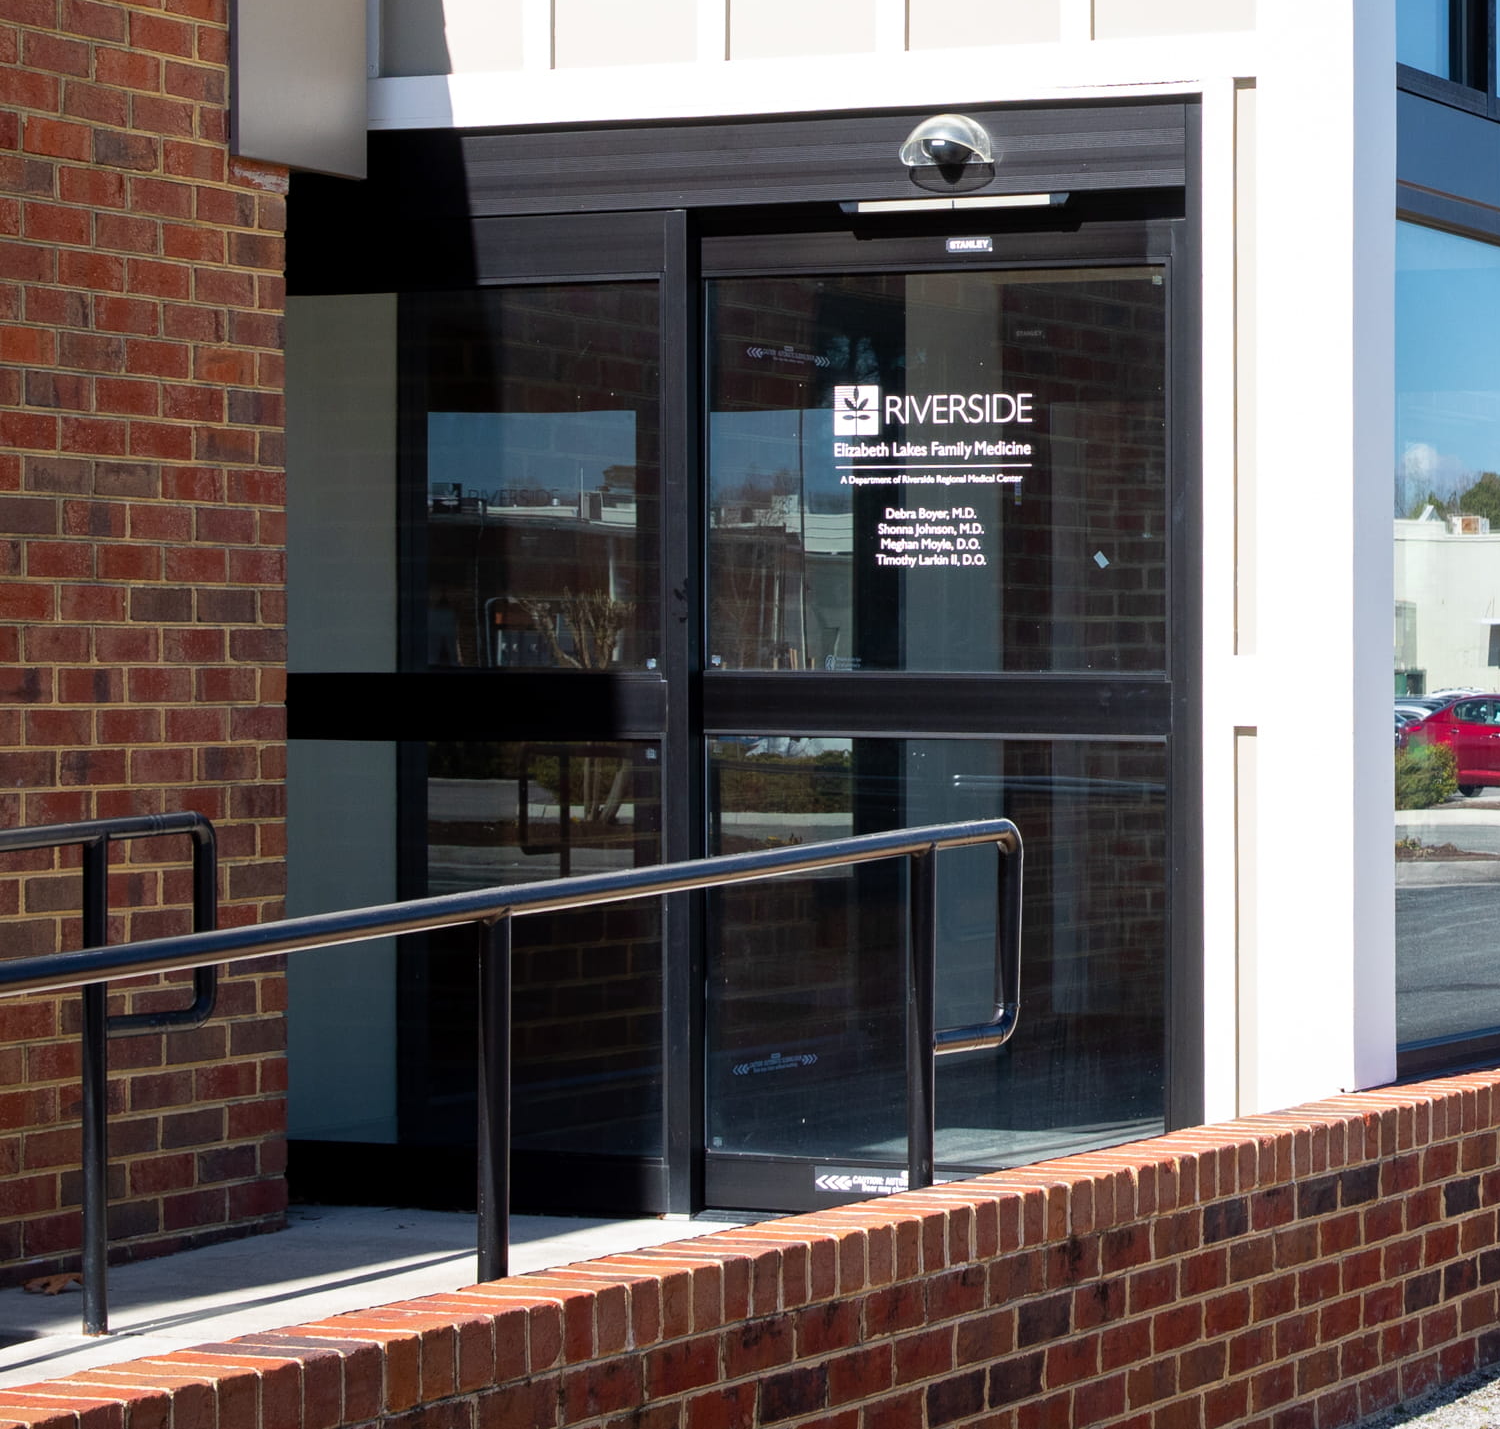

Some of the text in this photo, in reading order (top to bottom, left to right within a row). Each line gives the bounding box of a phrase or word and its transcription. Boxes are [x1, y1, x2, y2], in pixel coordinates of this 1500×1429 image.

[949, 239, 989, 250] STANLEY
[885, 393, 1033, 425] RIVERSIDE
[834, 440, 1032, 461] Elizabeth Lakes Family Medicine
[840, 473, 1023, 487] A Department of Riverside Regional Medical Center
[885, 507, 977, 522] Debra Boyer, M.D.
[877, 522, 985, 538] Shonna Johnson, M.D.
[880, 538, 981, 553] Meghan Moyle, D.O.
[875, 553, 917, 568] Timothy
[918, 553, 949, 566] Larkin
[962, 553, 987, 566] D.O.
